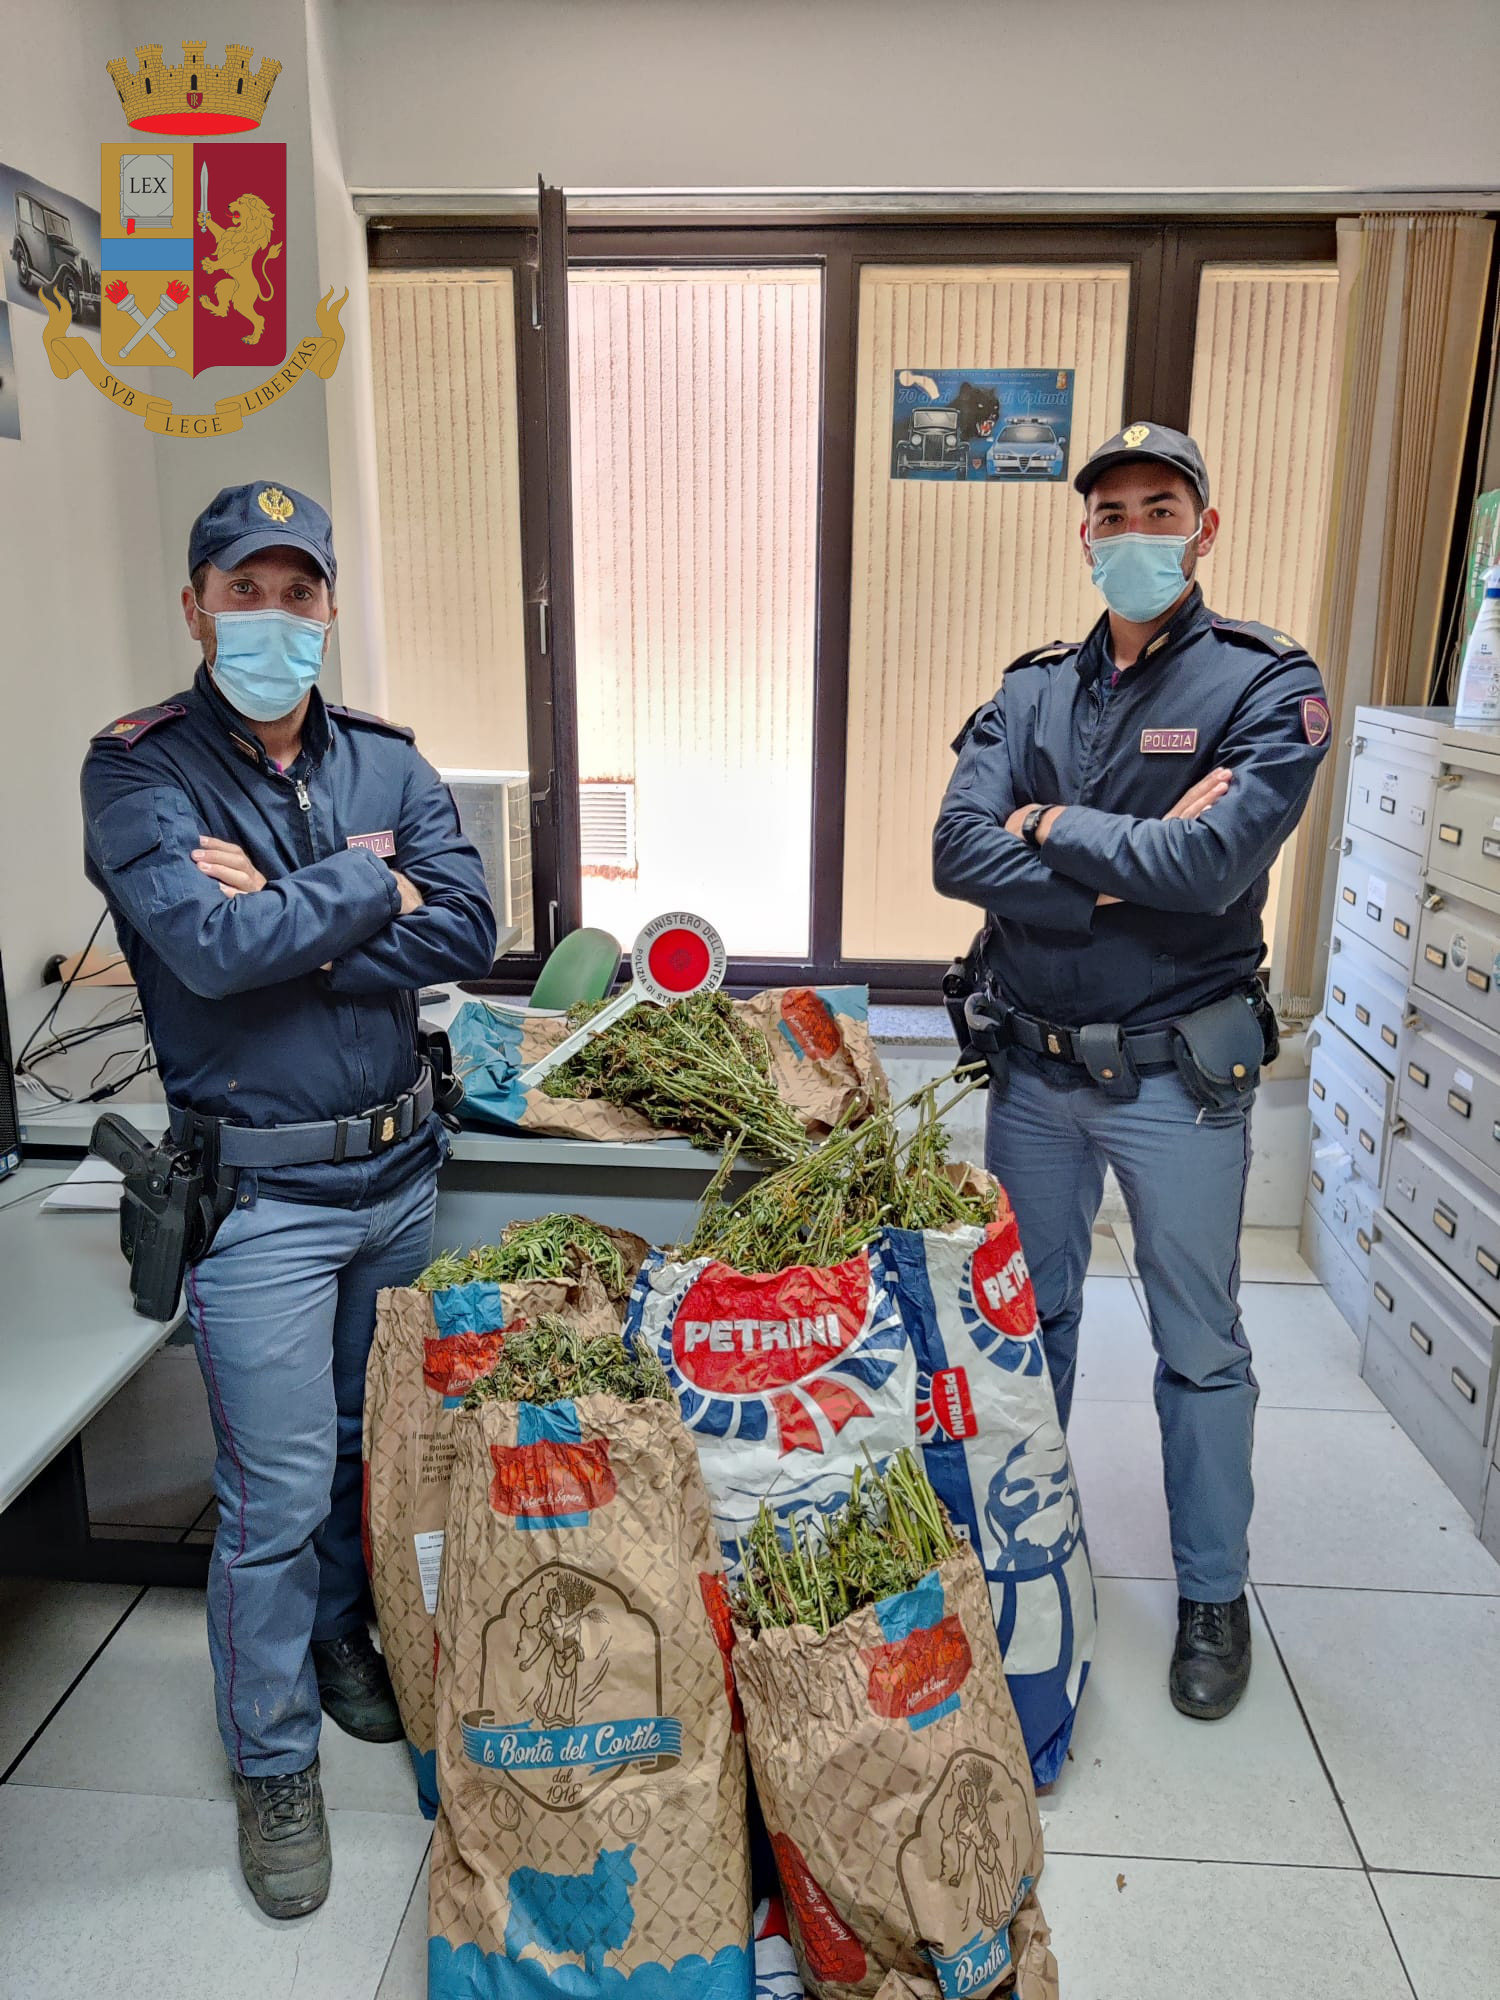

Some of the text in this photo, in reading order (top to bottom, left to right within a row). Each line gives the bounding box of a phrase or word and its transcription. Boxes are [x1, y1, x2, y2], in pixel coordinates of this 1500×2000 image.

[1143, 734, 1192, 748] POLIZIA
[644, 914, 701, 939] MINISTERO
[634, 948, 648, 985] POLIZIA
[646, 984, 657, 996] DI
[684, 1313, 843, 1353] PETRINI
[943, 1372, 965, 1437] PETRINI
[483, 1739, 496, 1763] le
[560, 1733, 586, 1762] del
[595, 1722, 662, 1757] Cortile
[552, 1767, 574, 1784] dal
[546, 1783, 583, 1804] 1918
